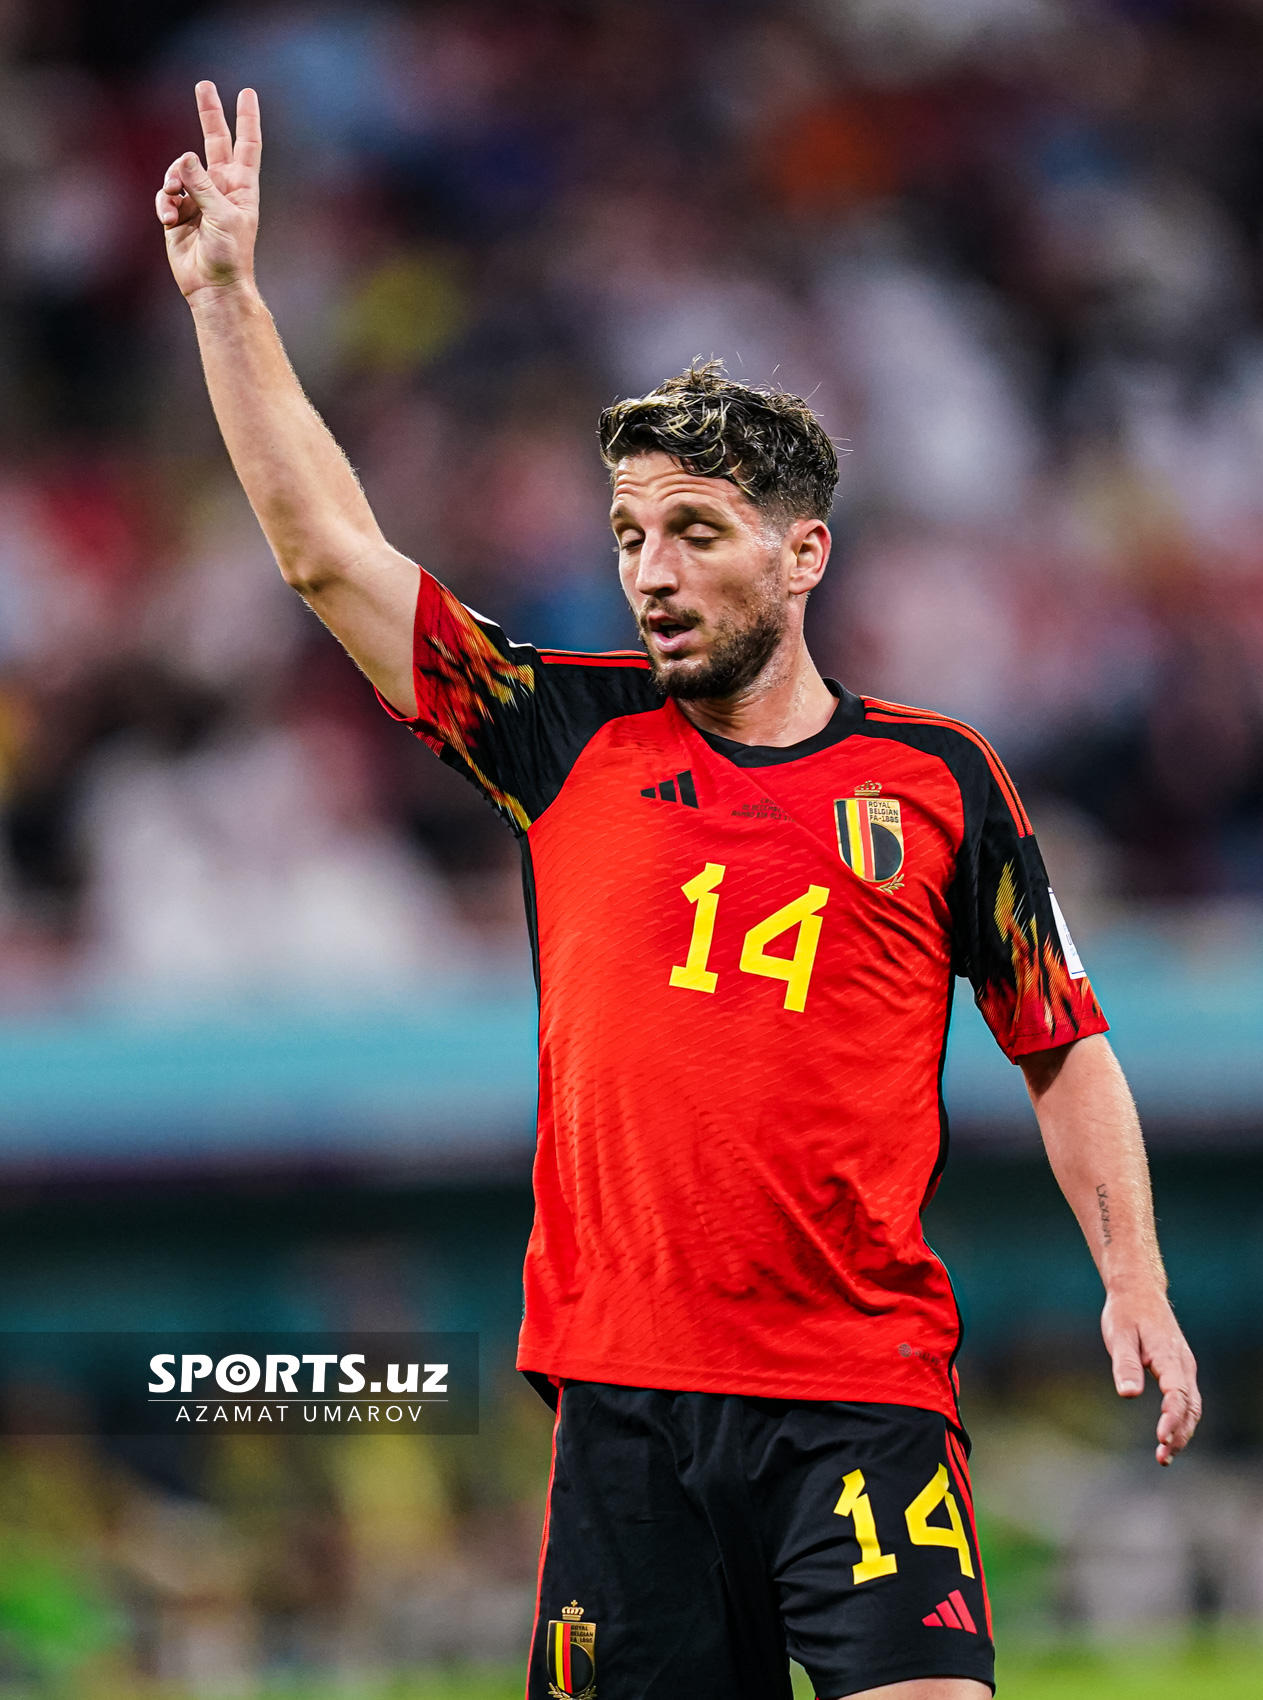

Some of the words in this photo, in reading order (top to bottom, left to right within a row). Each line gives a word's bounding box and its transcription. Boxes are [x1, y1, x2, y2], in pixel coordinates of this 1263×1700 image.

[868, 801, 891, 809] ROYAL
[869, 807, 899, 816] BELGIAN
[669, 862, 830, 1013] 14
[833, 1462, 976, 1585] 14
